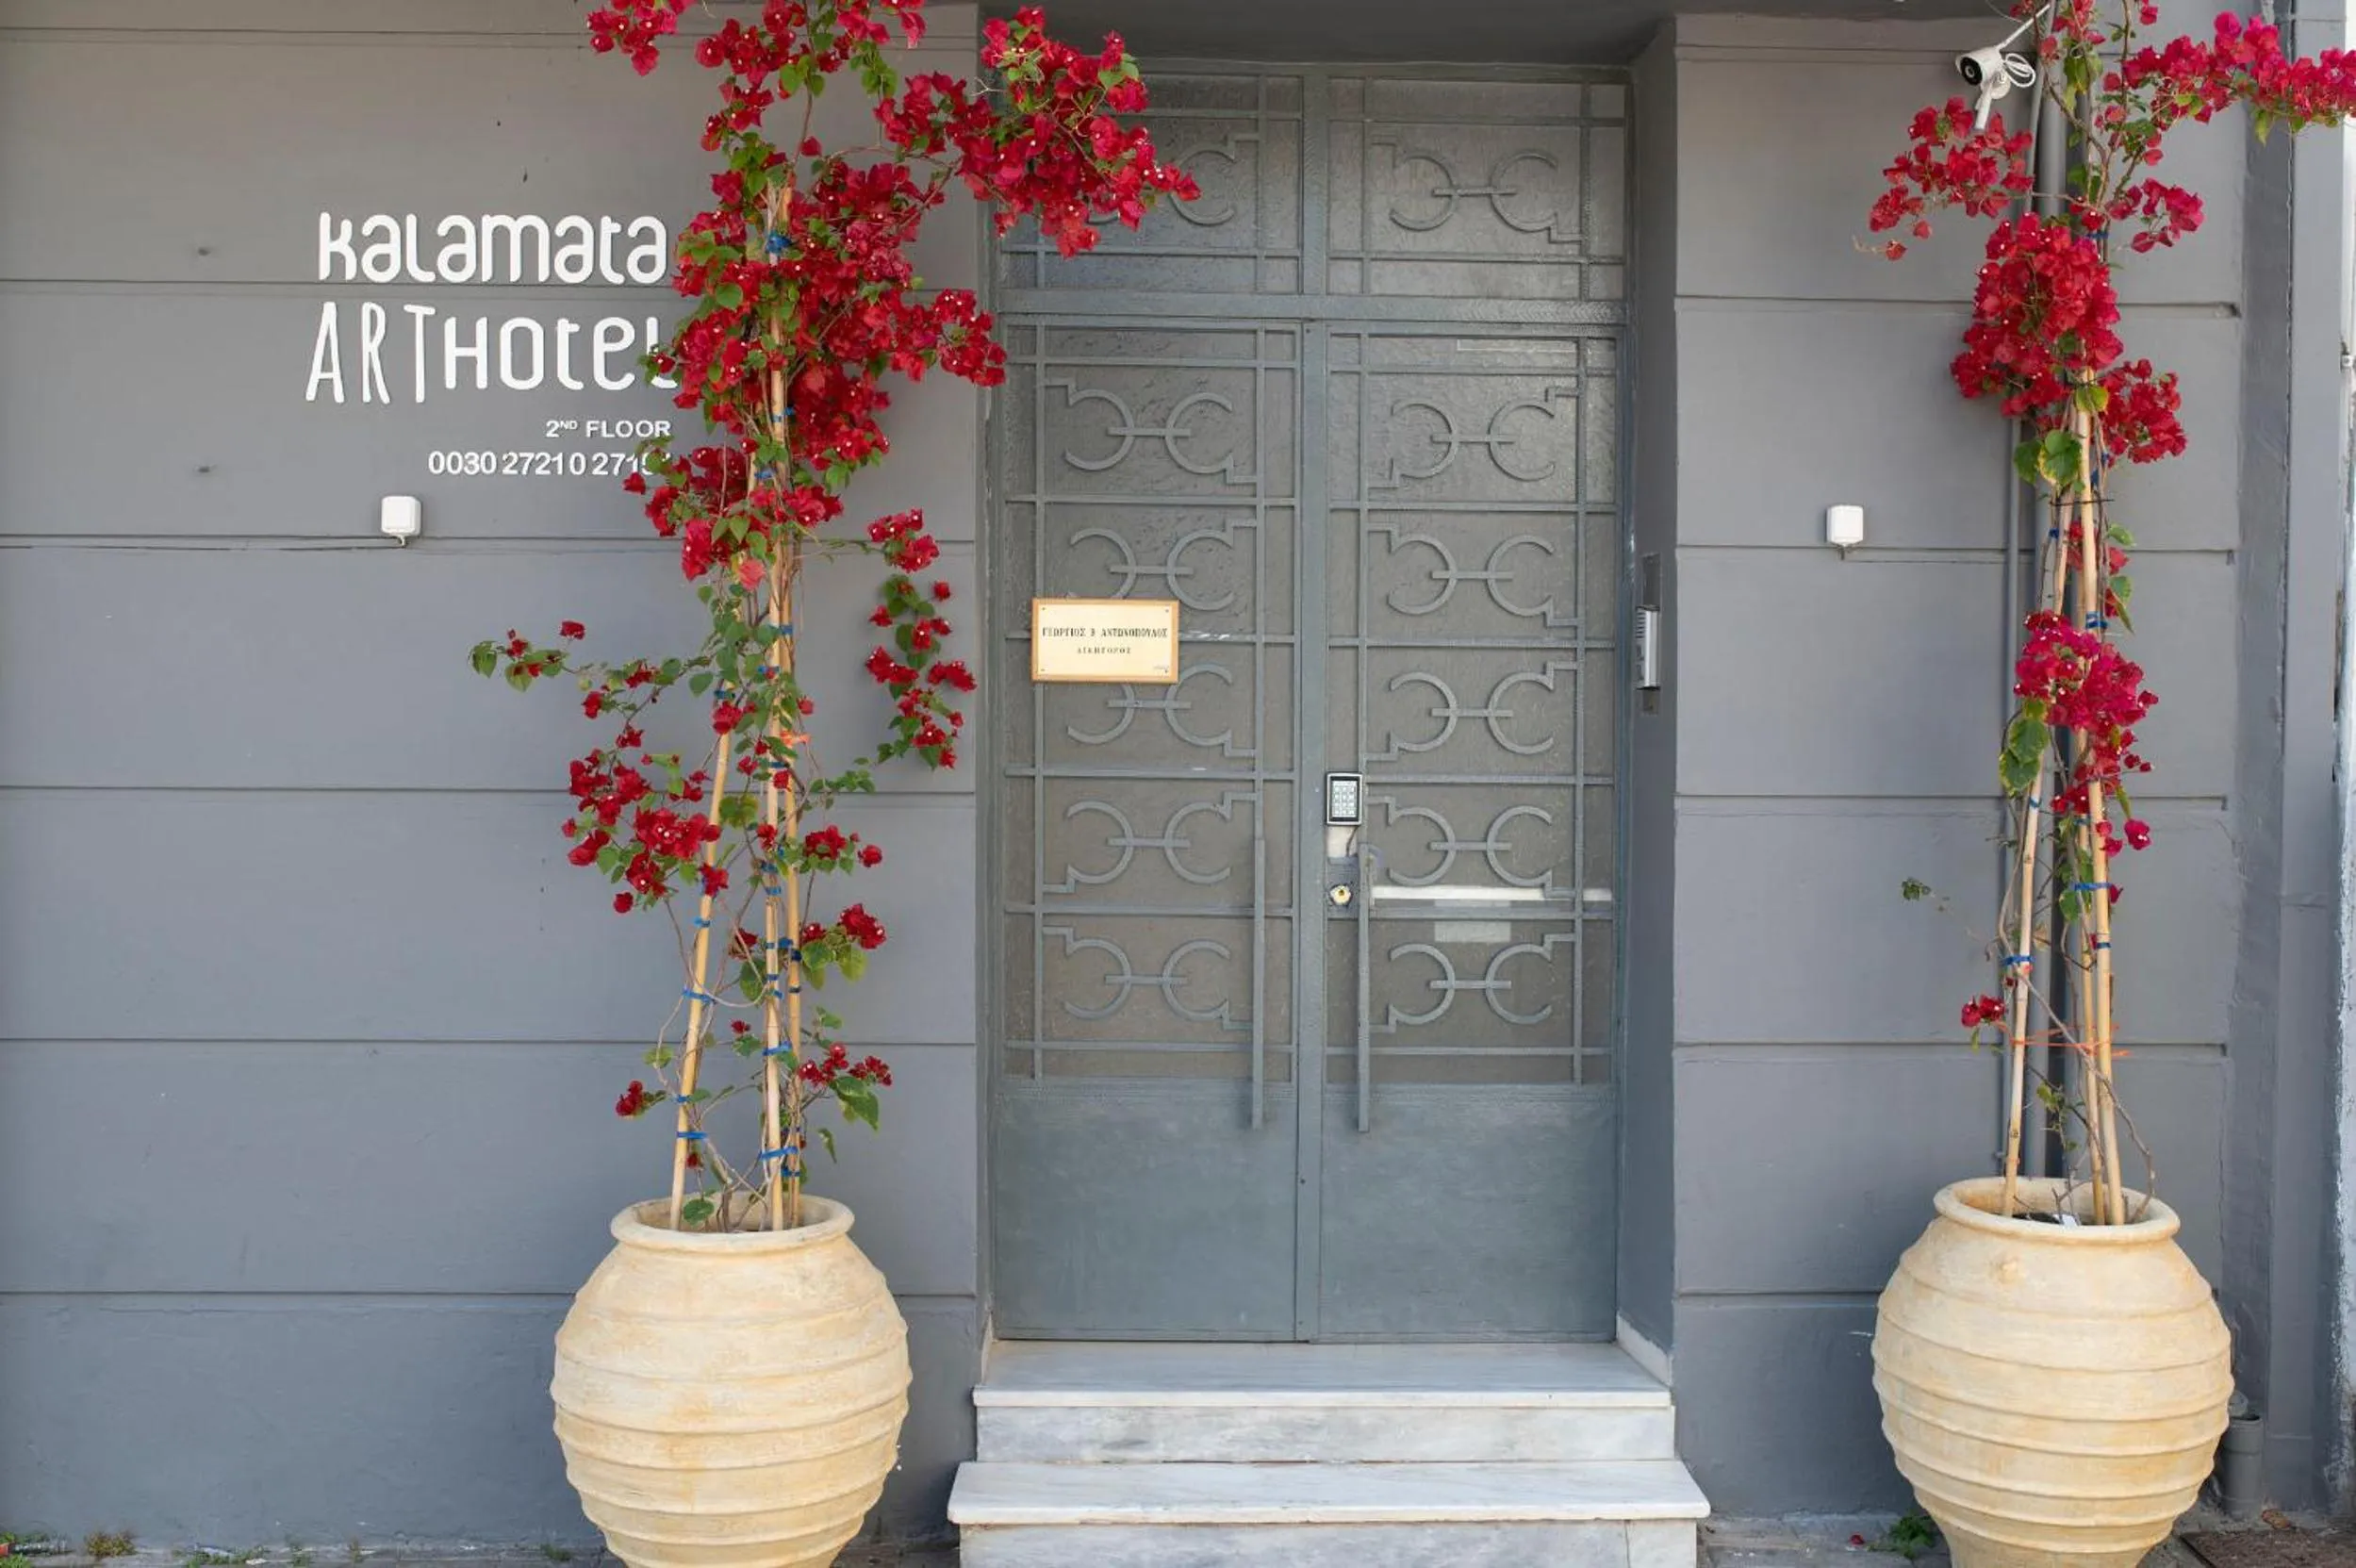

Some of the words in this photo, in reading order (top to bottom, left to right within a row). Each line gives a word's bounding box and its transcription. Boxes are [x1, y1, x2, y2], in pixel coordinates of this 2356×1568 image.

[319, 212, 667, 284] kalamata
[585, 420, 671, 438] FLOOR
[428, 451, 497, 475] 0030
[502, 451, 586, 476] 27210
[591, 452, 671, 476] 271
